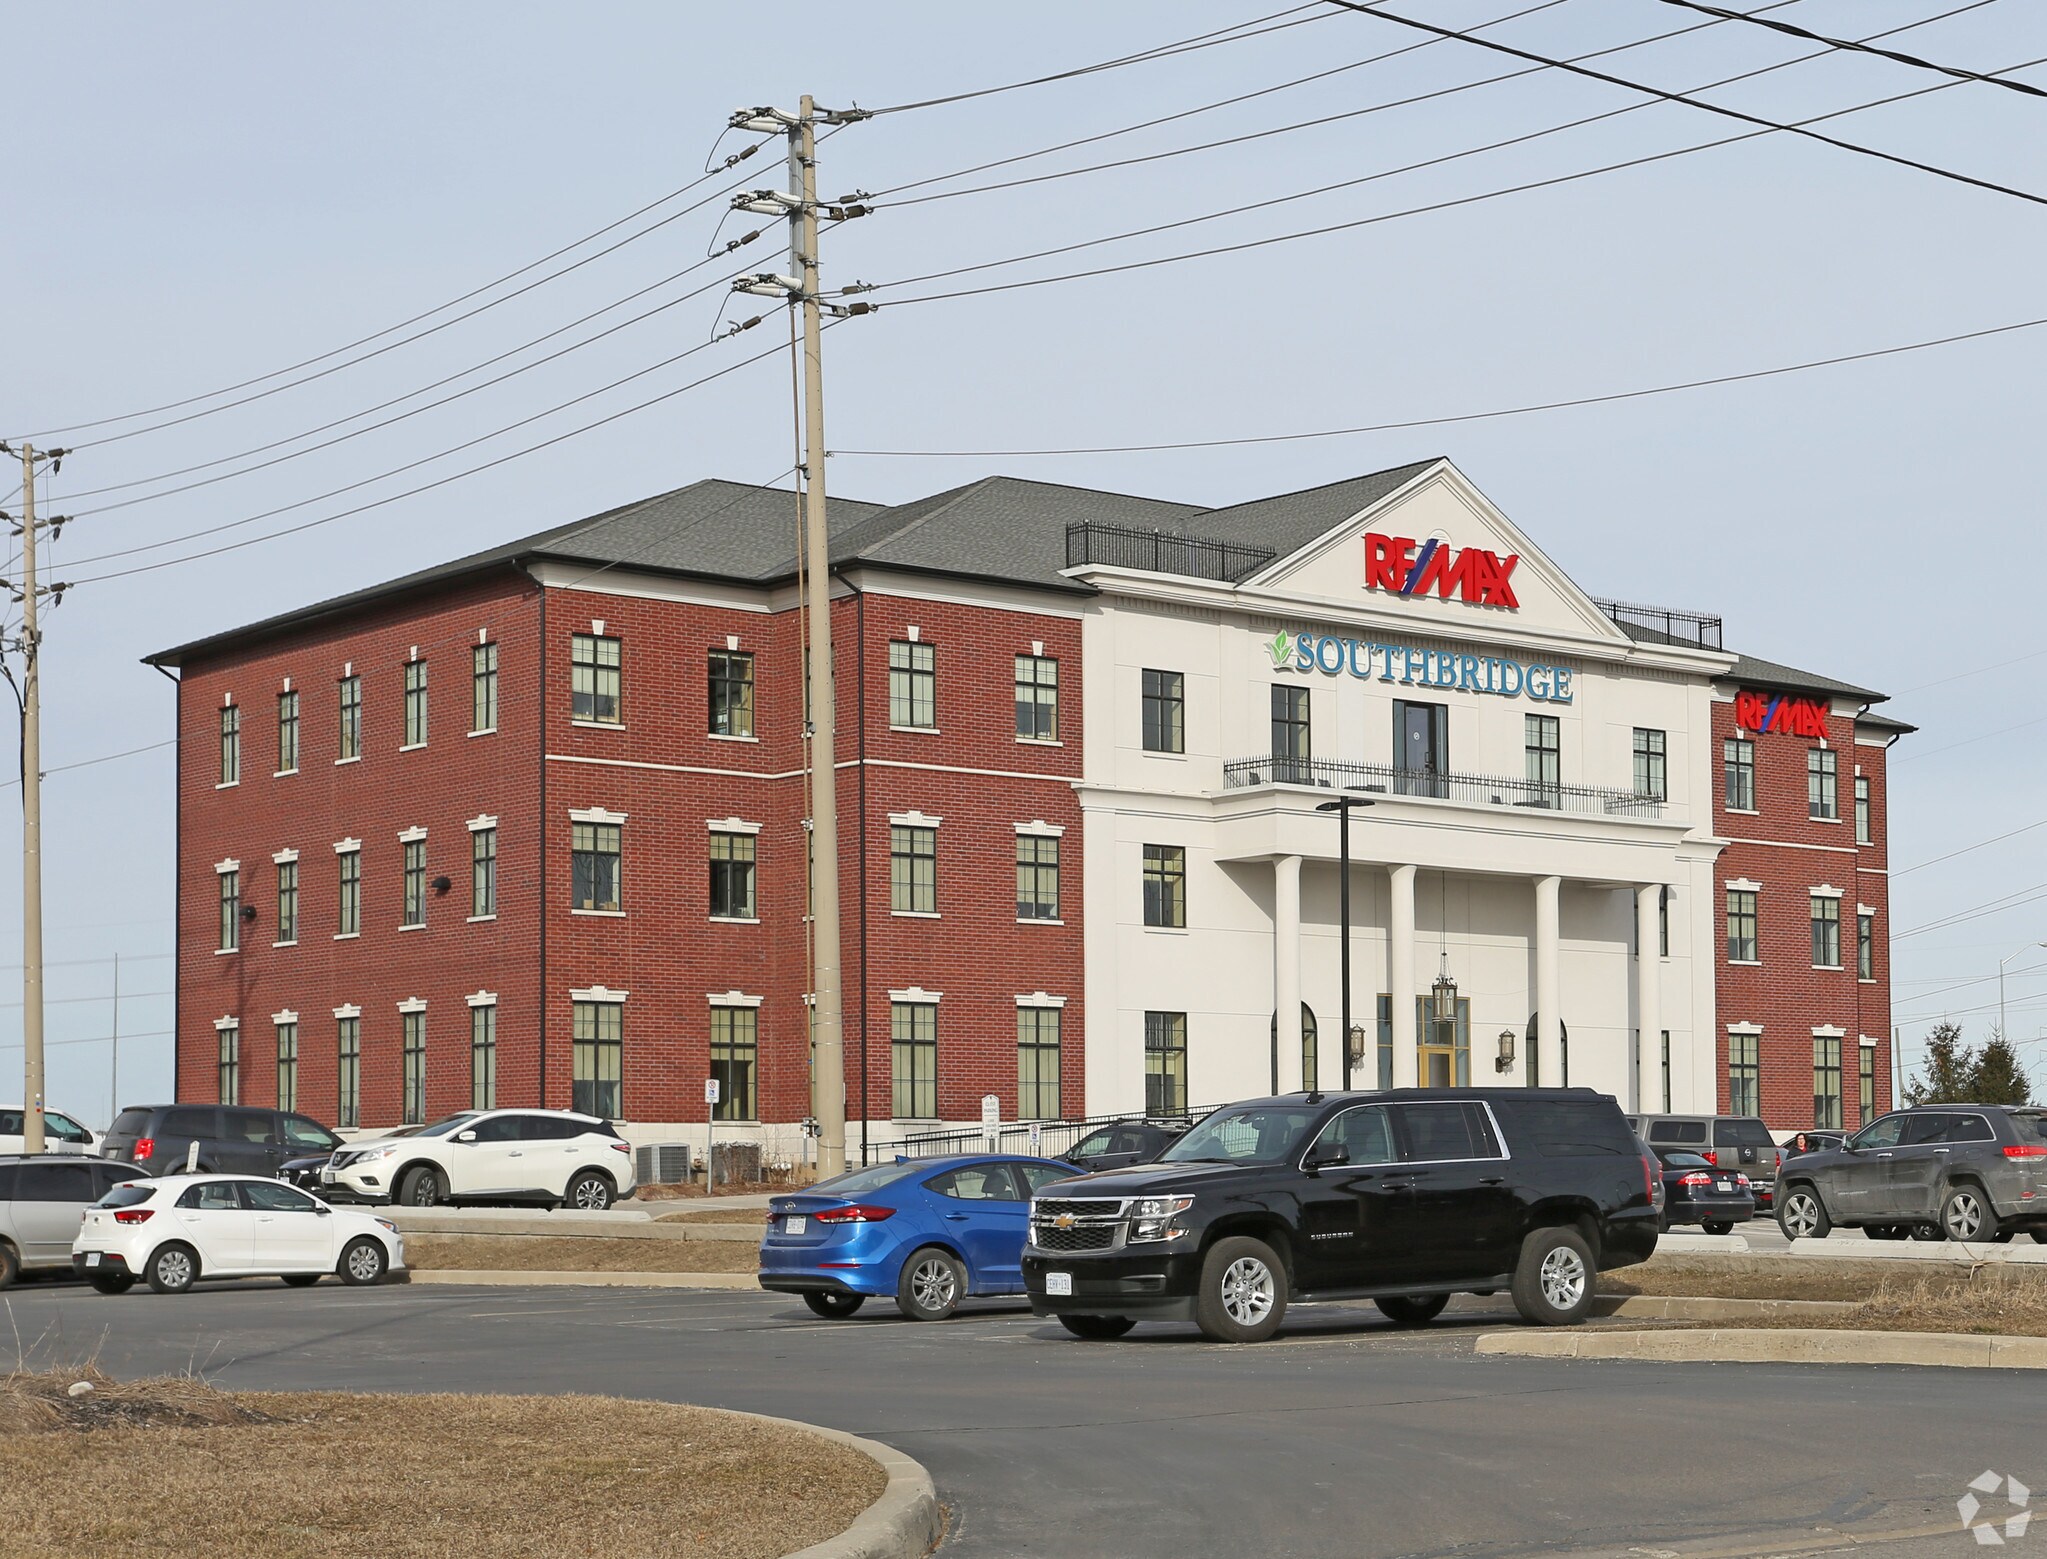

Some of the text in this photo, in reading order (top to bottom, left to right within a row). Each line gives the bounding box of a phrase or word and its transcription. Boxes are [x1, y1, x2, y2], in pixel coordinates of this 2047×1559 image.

[1364, 532, 1520, 609] RE/MAX
[1296, 631, 1575, 703] SOUTHBRIDGE
[1735, 690, 1830, 738] RE/MAX
